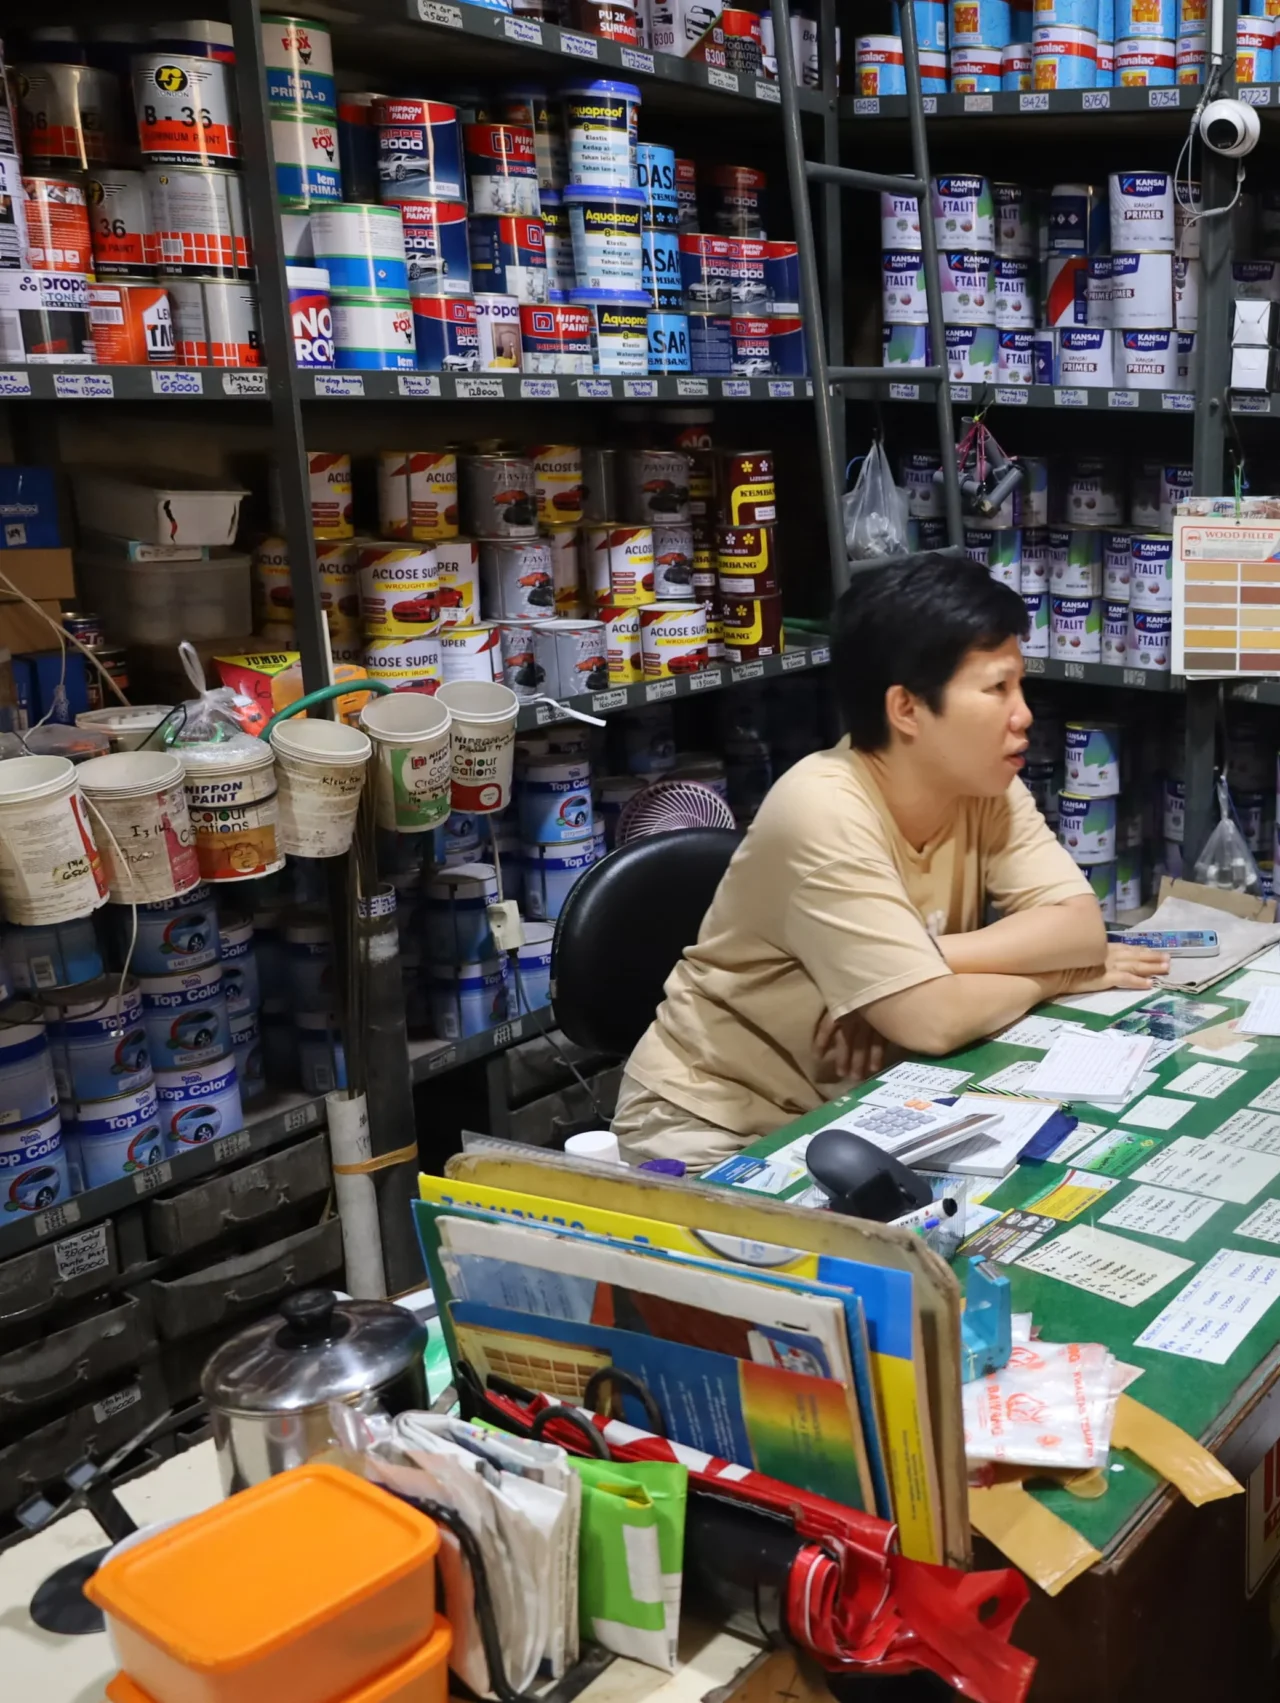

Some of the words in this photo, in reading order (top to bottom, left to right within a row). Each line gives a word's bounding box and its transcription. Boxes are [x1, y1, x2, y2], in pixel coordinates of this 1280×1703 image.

[282, 36, 312, 51] FOX
[654, 32, 674, 45] 6300
[705, 48, 725, 66] 6300
[1117, 54, 1155, 67] Danalac
[271, 86, 325, 101] PRIMA-D
[1150, 91, 1178, 105] 8754
[1240, 89, 1269, 103] 8723
[854, 99, 878, 113] 9488
[1021, 96, 1048, 109] 9424
[1084, 94, 1109, 108] 8760
[389, 106, 422, 114] NIPPON
[144, 105, 156, 125] B
[181, 106, 212, 128] 36
[392, 113, 417, 121] PAINT
[312, 135, 333, 149] FOX
[381, 139, 423, 150] 2000
[317, 173, 335, 185] lem
[950, 179, 981, 189] KANSAI
[1136, 178, 1165, 187] KANSAI
[942, 200, 975, 213] FTALIT
[406, 212, 432, 221] PAINT
[586, 209, 639, 223] Aquaproof
[1124, 209, 1163, 220] PRIMER
[891, 255, 920, 264] KANSAI
[961, 255, 990, 265] KANSAI
[730, 267, 764, 279] 2000
[885, 275, 914, 287] FTALIT
[955, 276, 987, 288] FTALIT
[292, 308, 332, 338] NO
[393, 318, 412, 332] FOX
[562, 323, 588, 333] PAINT
[1071, 333, 1100, 342] KANSAI
[1137, 334, 1168, 343] KANSAI
[737, 348, 770, 356] 2000
[1062, 363, 1097, 373] PRIMER
[1127, 364, 1164, 374] PRIMER
[81, 386, 112, 395] 135000
[161, 382, 200, 393] 65000
[468, 387, 498, 396] 128000
[1205, 531, 1240, 539] WOOD
[1141, 542, 1170, 553] KANSAI
[373, 568, 418, 580] ACLOSE
[1134, 562, 1164, 576] FTALIT
[1061, 600, 1089, 610] KANSAI
[1055, 618, 1084, 630] FTALIT
[651, 626, 689, 637] ACLOSE
[245, 652, 288, 666] JUMBO
[407, 654, 438, 666] SUPER
[454, 754, 497, 766] Colour
[185, 782, 243, 795] NIPPON
[191, 791, 237, 804] PAINT
[151, 992, 182, 1007] Top
[187, 982, 222, 1002] Color
[158, 1086, 185, 1101] Top
[189, 1077, 227, 1096] Color
[106, 1114, 137, 1130] Top
